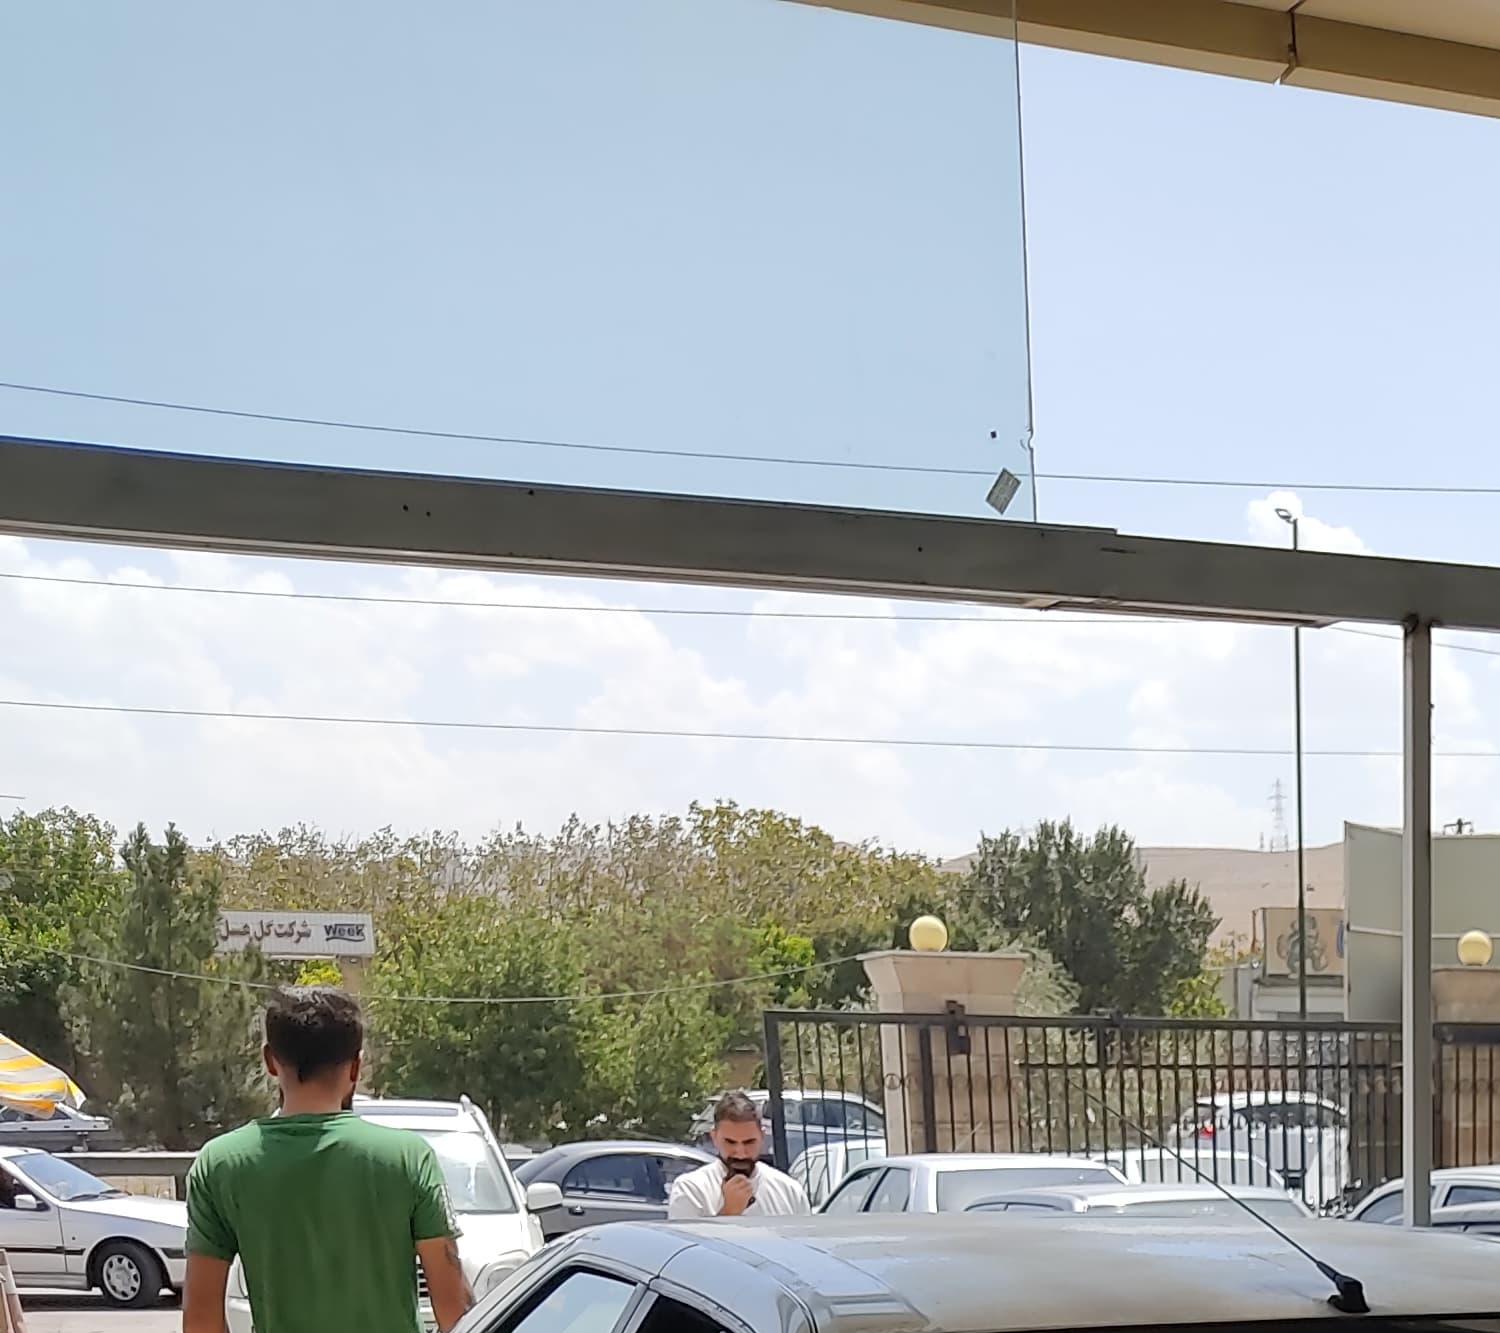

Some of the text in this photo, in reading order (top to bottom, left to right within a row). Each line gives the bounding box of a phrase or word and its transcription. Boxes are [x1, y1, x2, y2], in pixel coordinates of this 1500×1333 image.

[253, 919, 274, 940] گل
[274, 920, 311, 943] شرکت
[324, 923, 366, 937] Week
